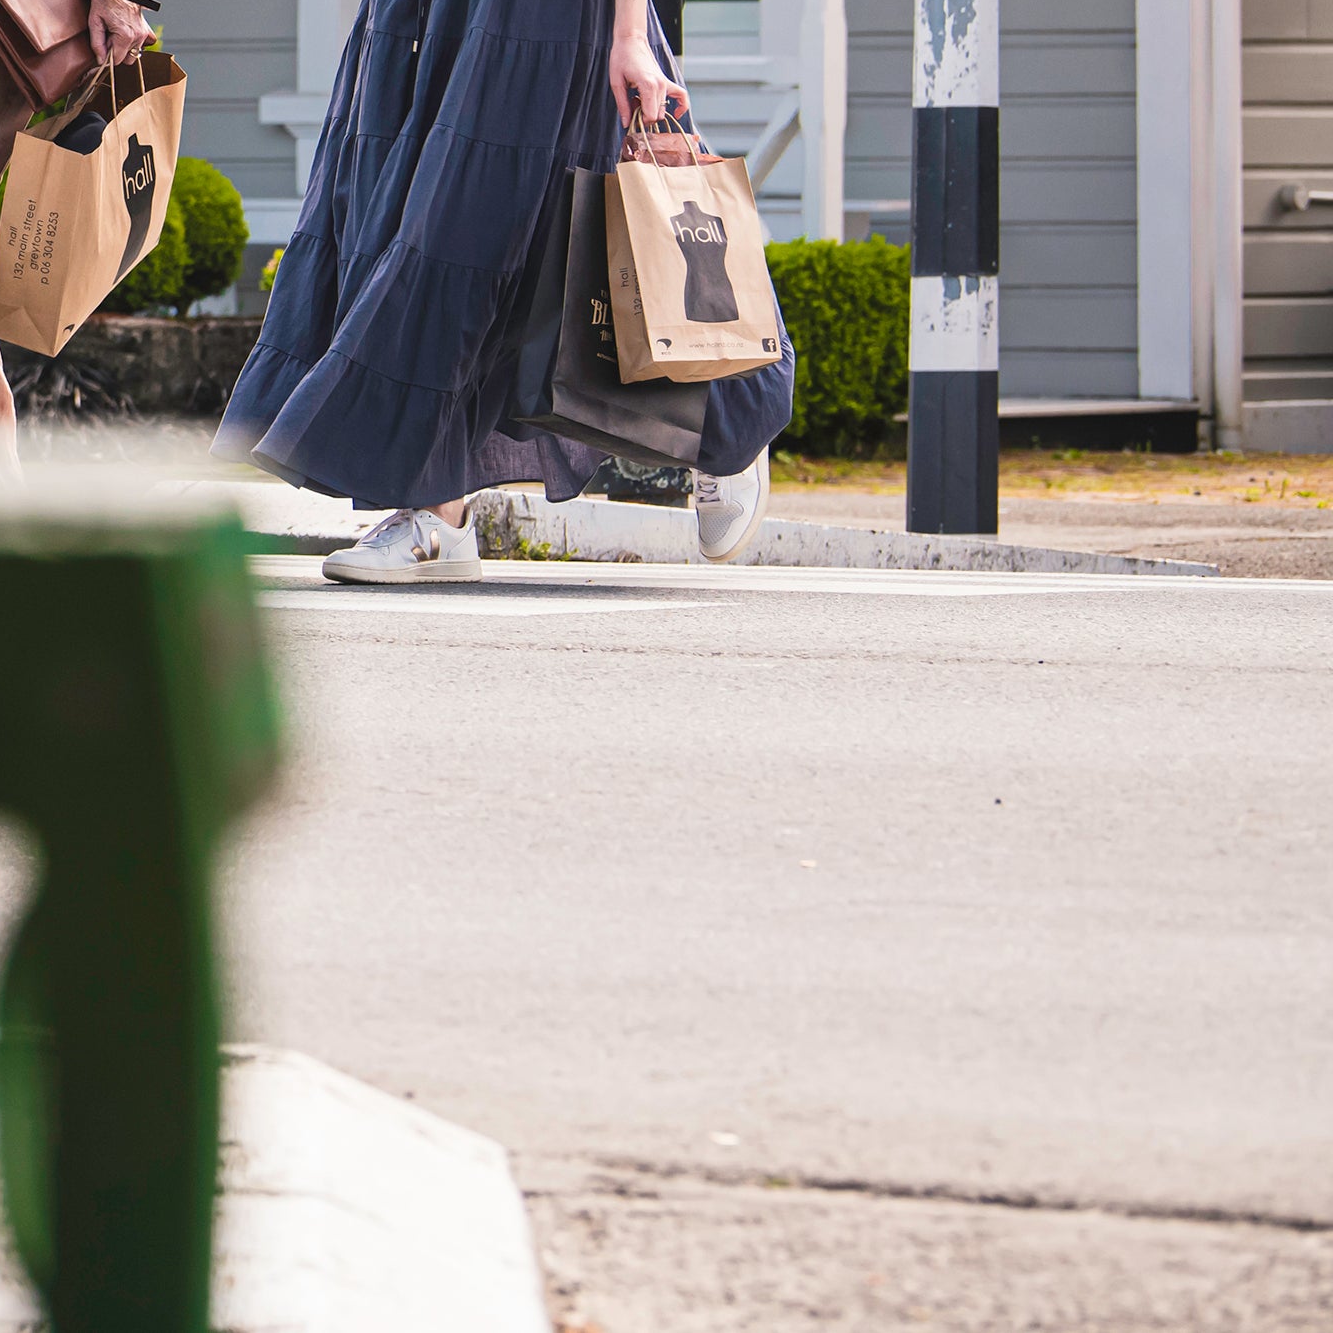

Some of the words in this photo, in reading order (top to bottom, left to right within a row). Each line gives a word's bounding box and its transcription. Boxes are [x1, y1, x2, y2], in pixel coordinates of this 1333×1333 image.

[123, 153, 153, 199] hall
[23, 199, 37, 231] street
[46, 212, 59, 237] 8253
[8, 226, 18, 246] hall
[675, 221, 723, 243] hall
[18, 233, 29, 260] main
[30, 219, 44, 271] greytown
[43, 240, 54, 259] 304
[13, 262, 25, 280] 132
[40, 261, 51, 275] 06
[620, 267, 629, 288] hall
[40, 276, 50, 285] p
